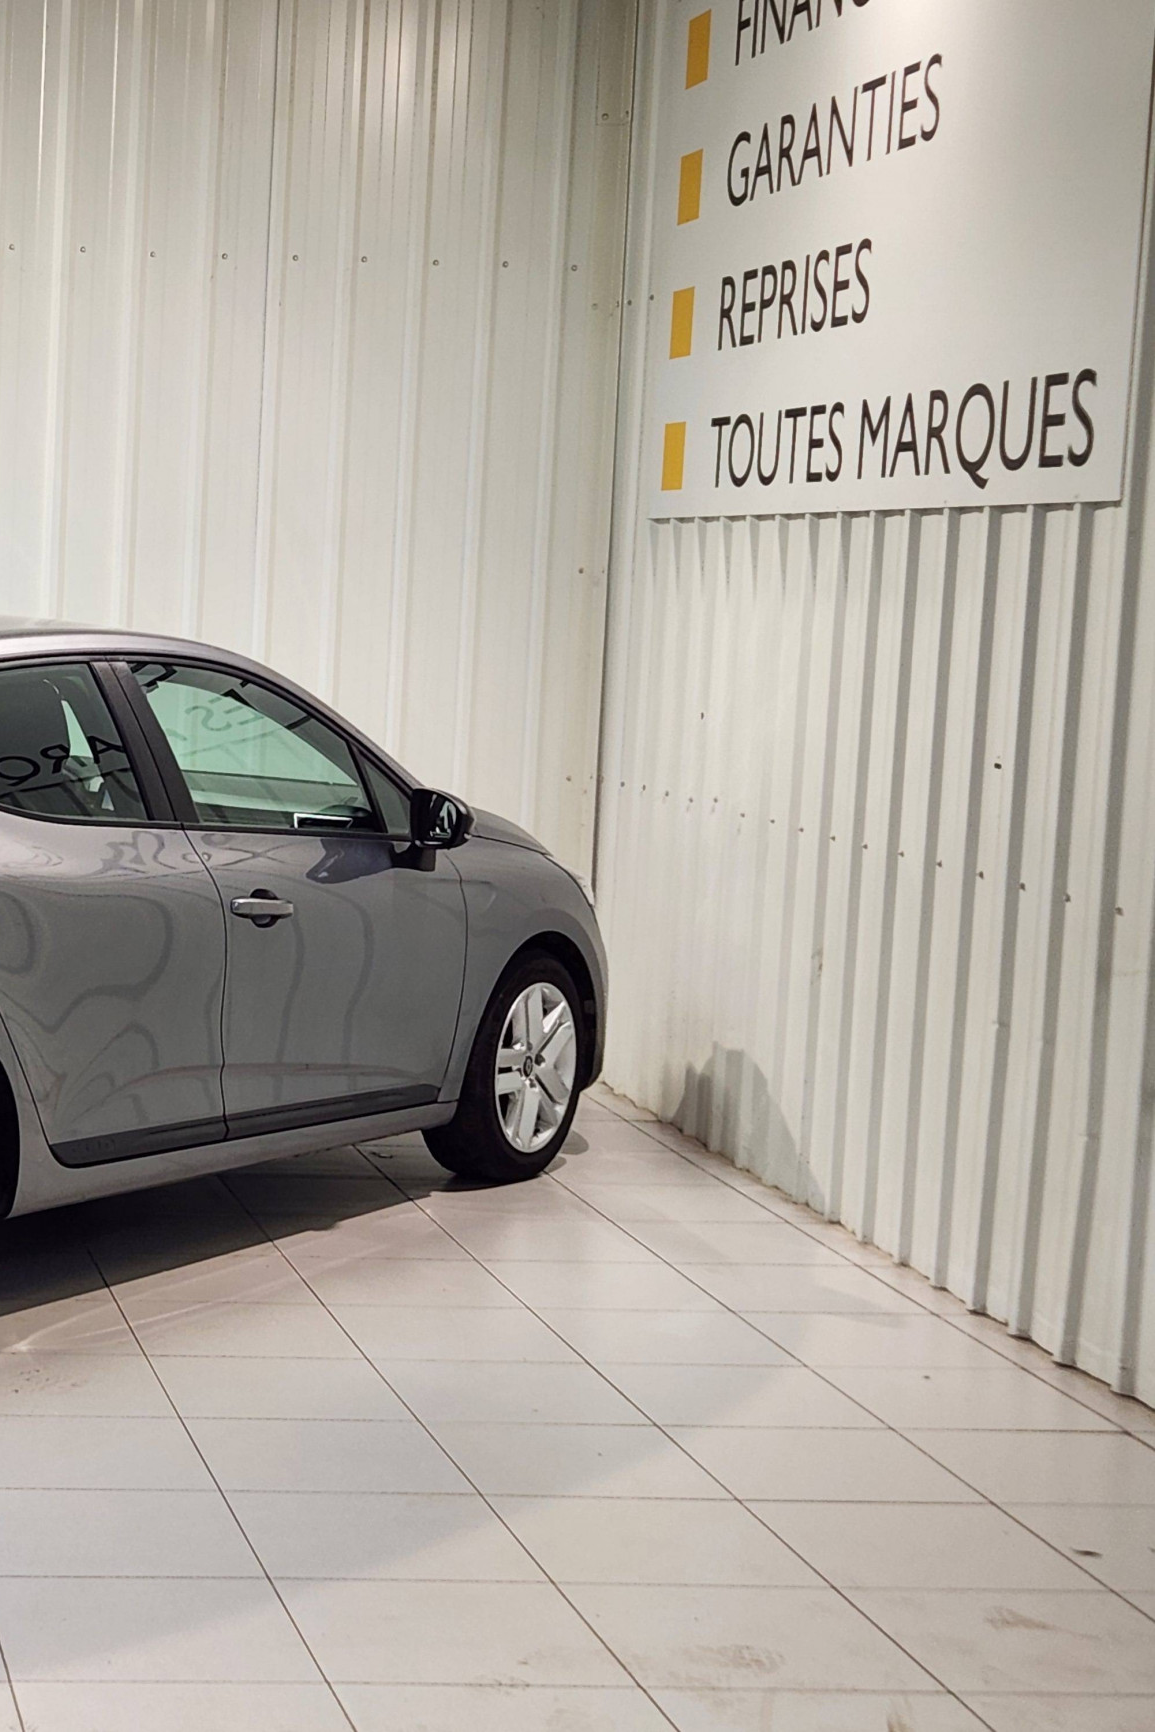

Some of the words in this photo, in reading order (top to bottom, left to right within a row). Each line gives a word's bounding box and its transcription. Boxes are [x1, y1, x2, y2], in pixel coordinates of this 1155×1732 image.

[725, 53, 943, 207] GARANTIES
[717, 238, 872, 352] REPRISES
[710, 401, 845, 489] TOUTES
[856, 368, 1097, 490] MARQUES
